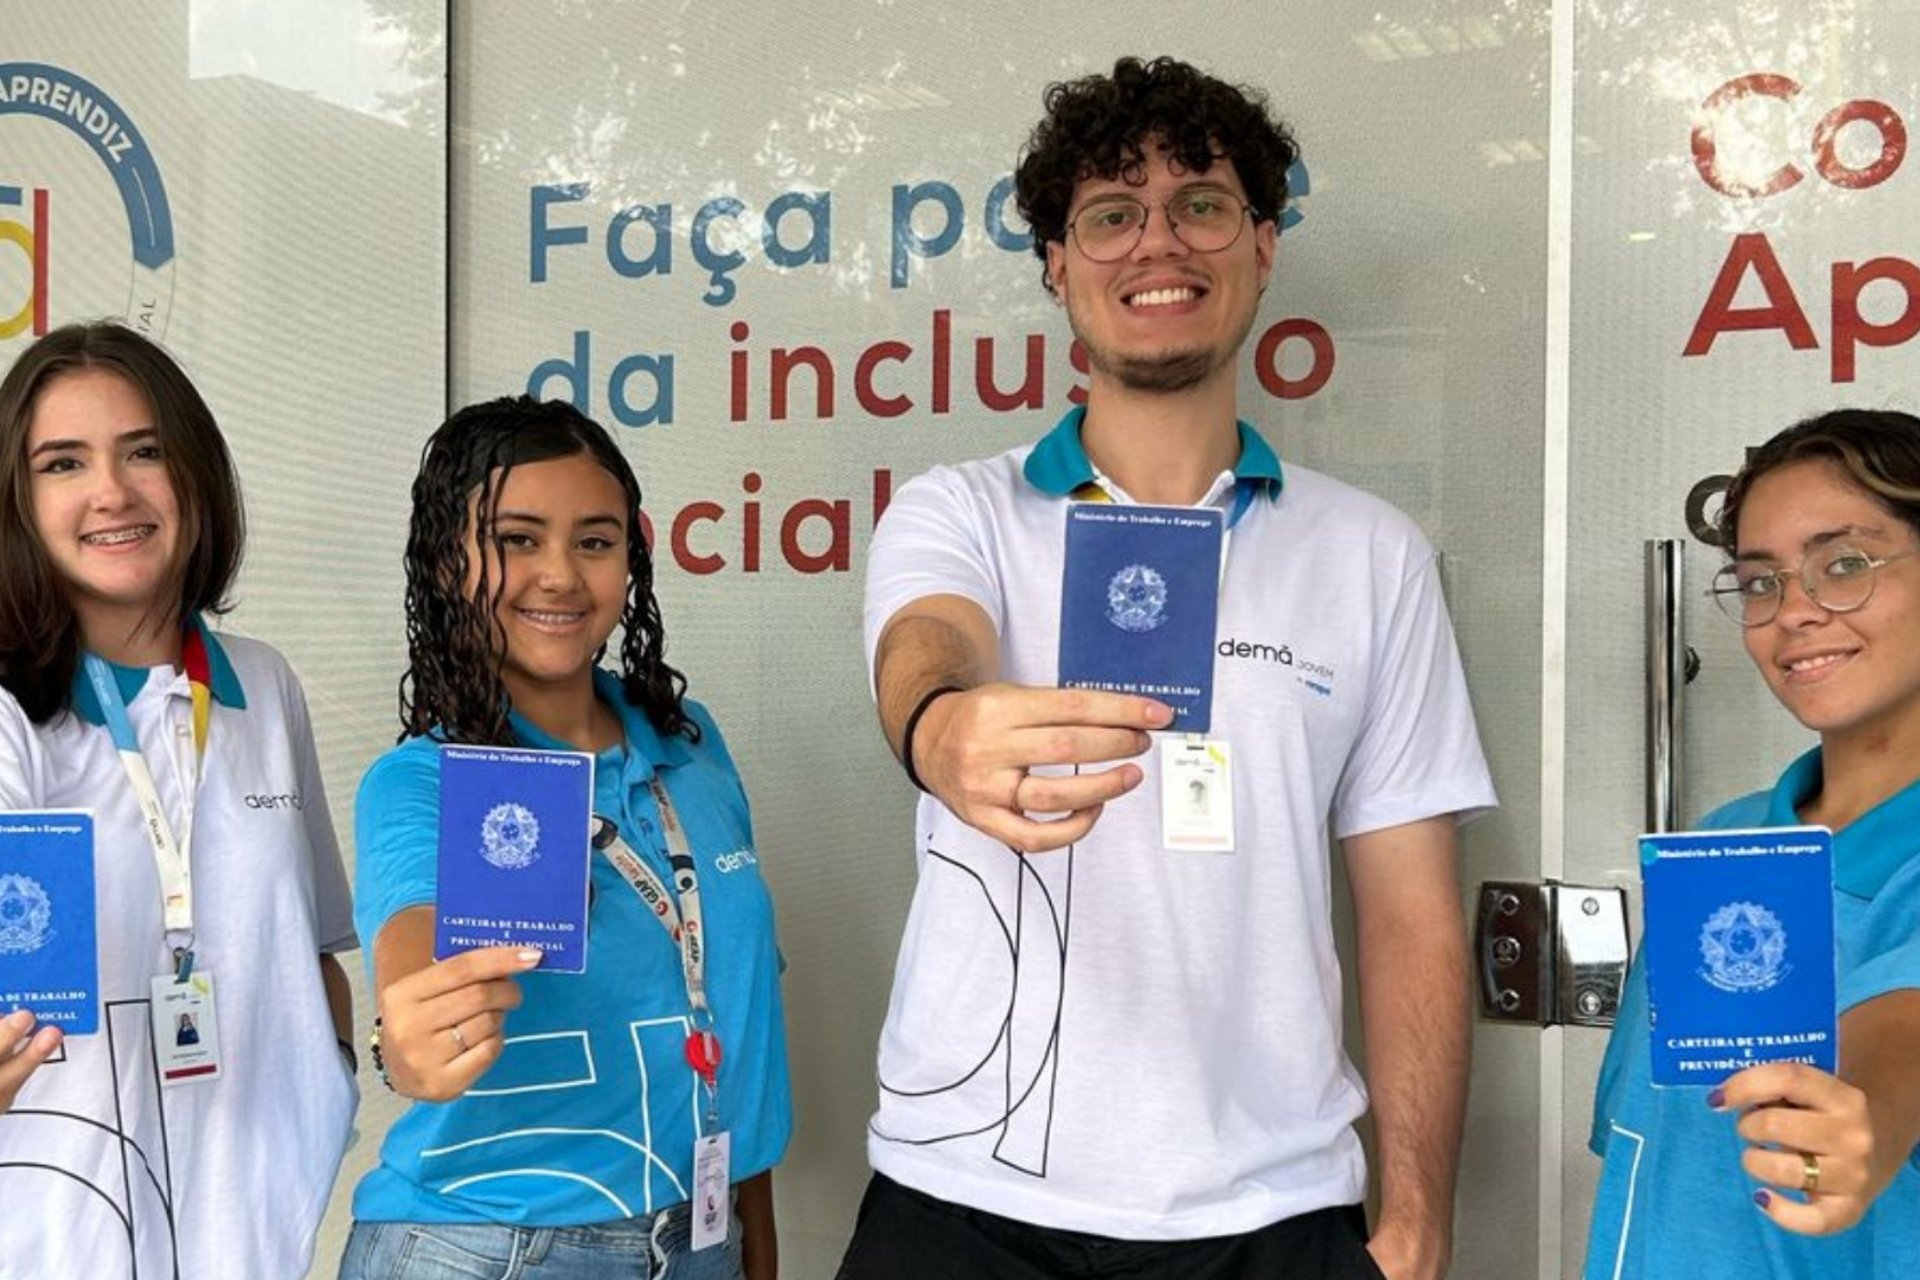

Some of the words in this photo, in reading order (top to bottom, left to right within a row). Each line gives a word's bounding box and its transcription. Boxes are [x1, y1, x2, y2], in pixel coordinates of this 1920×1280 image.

[529, 180, 832, 307] Faça
[1682, 233, 1920, 383] Ap
[526, 330, 674, 428] da
[729, 309, 1336, 423] incluo
[640, 469, 892, 576] cial
[1123, 683, 1137, 693] DE
[1140, 684, 1201, 696] TRABALHO
[1723, 845, 1768, 857] Trabalho
[1777, 844, 1823, 855] Emprego
[443, 915, 497, 928] CARTEIRA
[499, 920, 513, 929] DE
[515, 920, 576, 932] TRABALHO
[504, 930, 511, 939] E
[24, 991, 87, 1001] TRABALHO
[35, 1011, 79, 1020] SOCIAL
[1667, 1037, 1735, 1049] CARTEIRA
[1736, 1036, 1755, 1048] DE
[1756, 1031, 1827, 1046] TRABALHO
[1744, 1048, 1755, 1058] E
